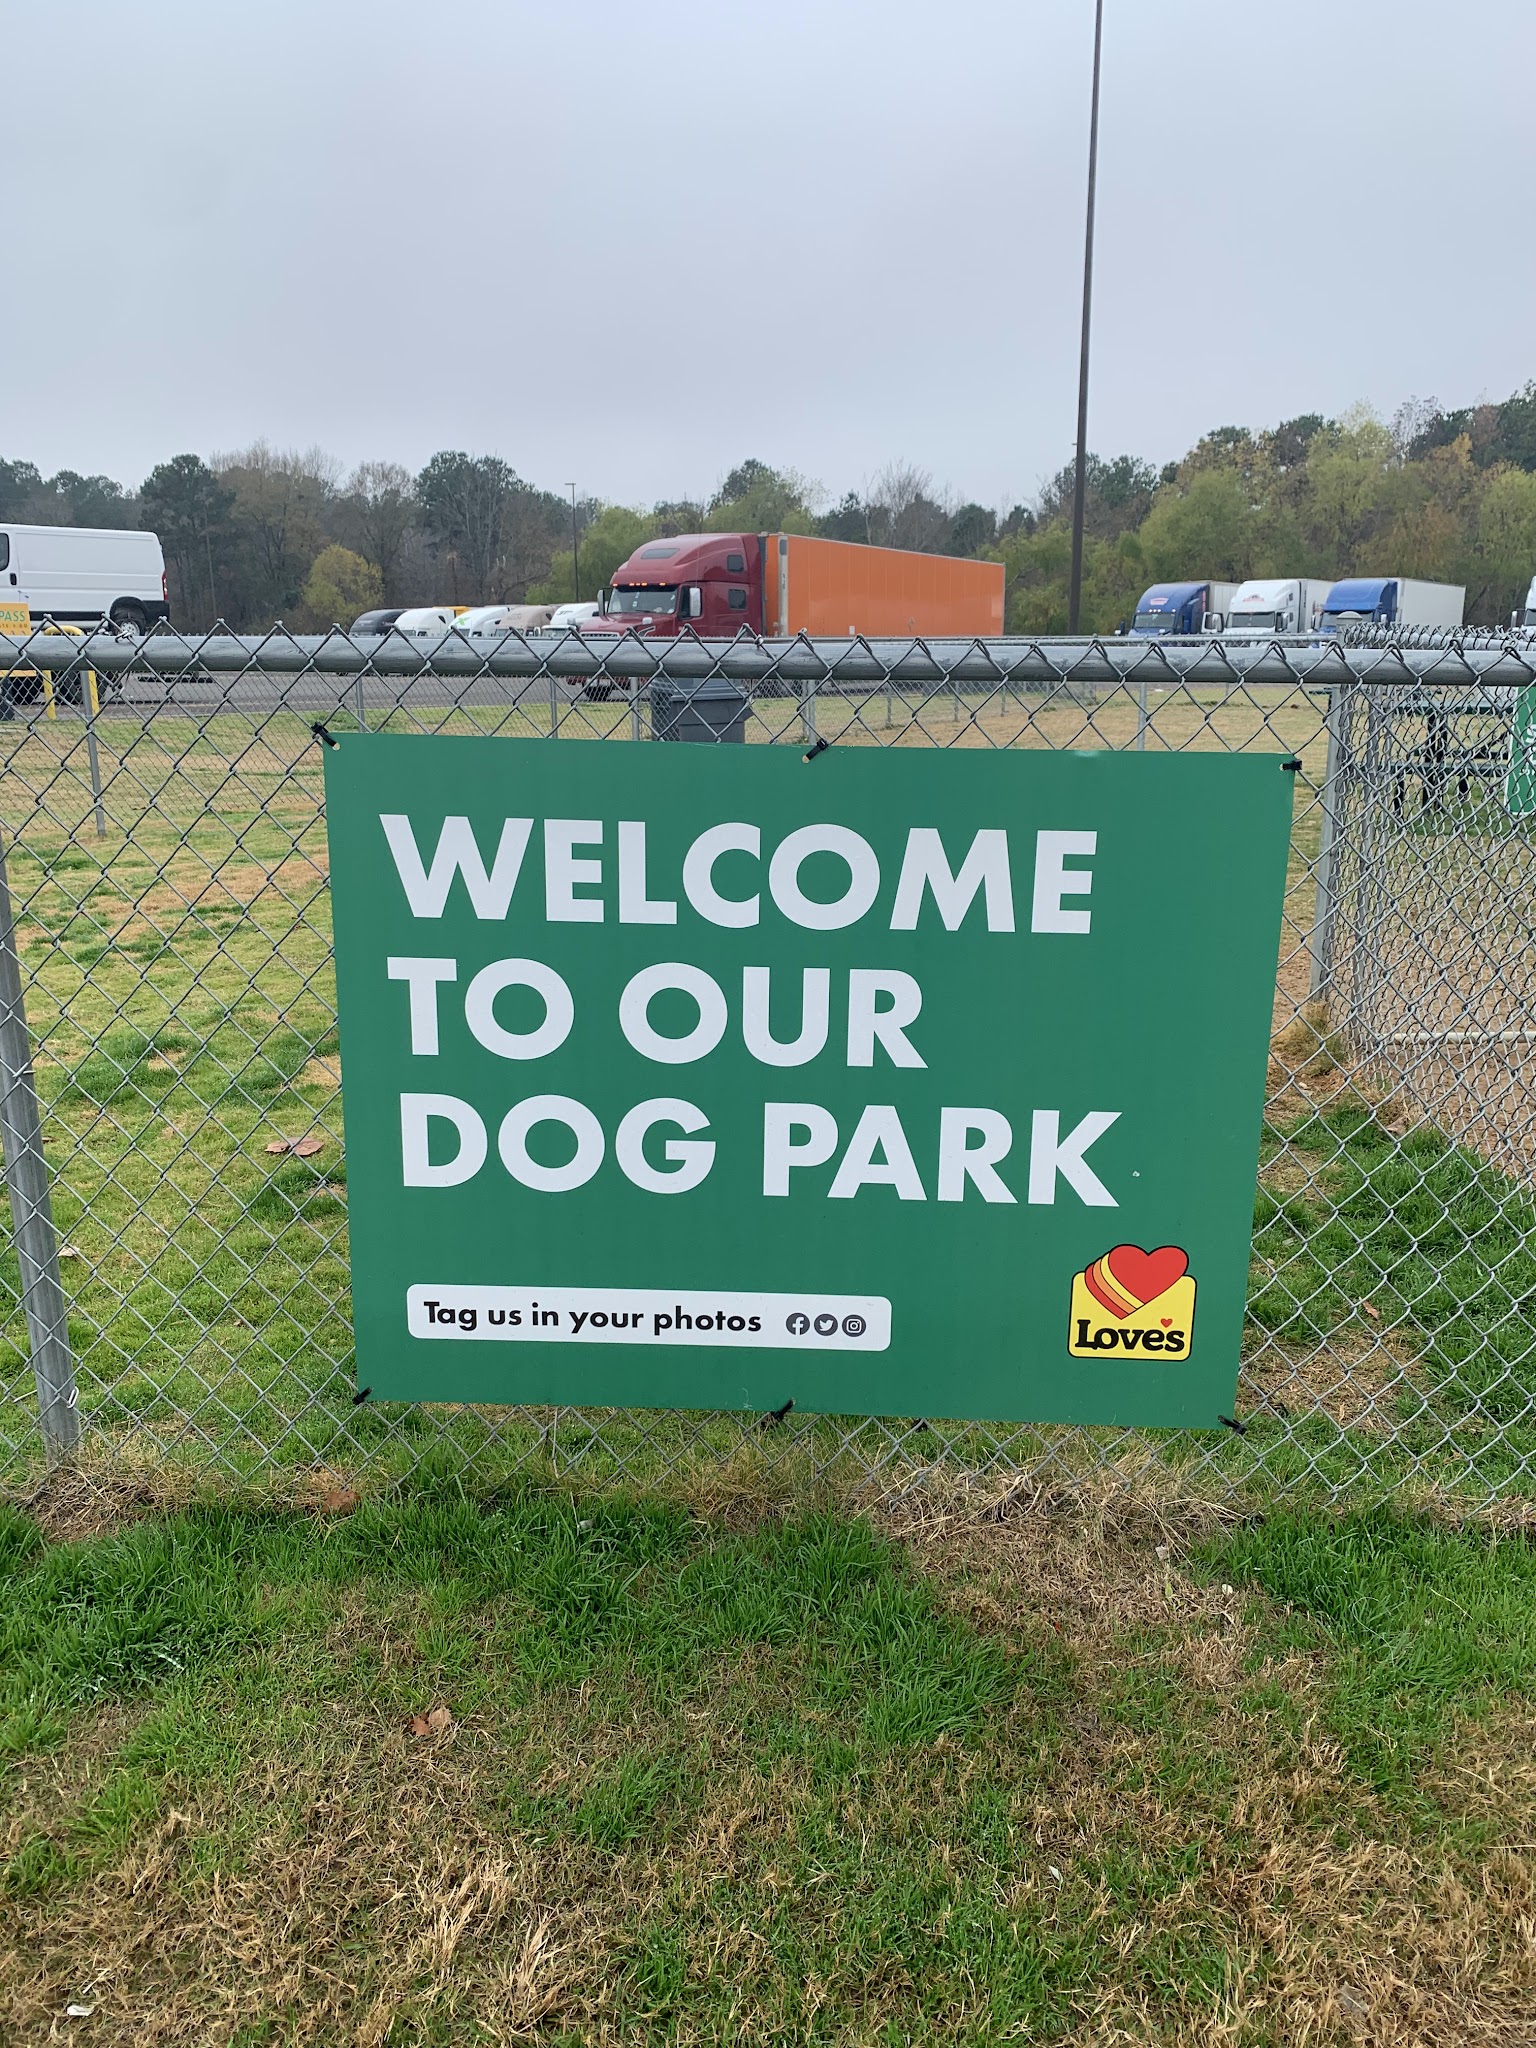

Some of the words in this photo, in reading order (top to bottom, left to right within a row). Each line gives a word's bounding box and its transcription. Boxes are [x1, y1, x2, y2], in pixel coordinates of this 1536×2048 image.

[378, 813, 1098, 935] WELCOME
[386, 956, 575, 1061] TO
[618, 962, 929, 1069] OUR
[399, 1092, 717, 1197] DOG
[762, 1102, 1122, 1208] PARK
[423, 1301, 478, 1332] Tag
[488, 1309, 522, 1326] us
[531, 1301, 559, 1326] in
[568, 1311, 644, 1334] your
[654, 1305, 762, 1336] photos
